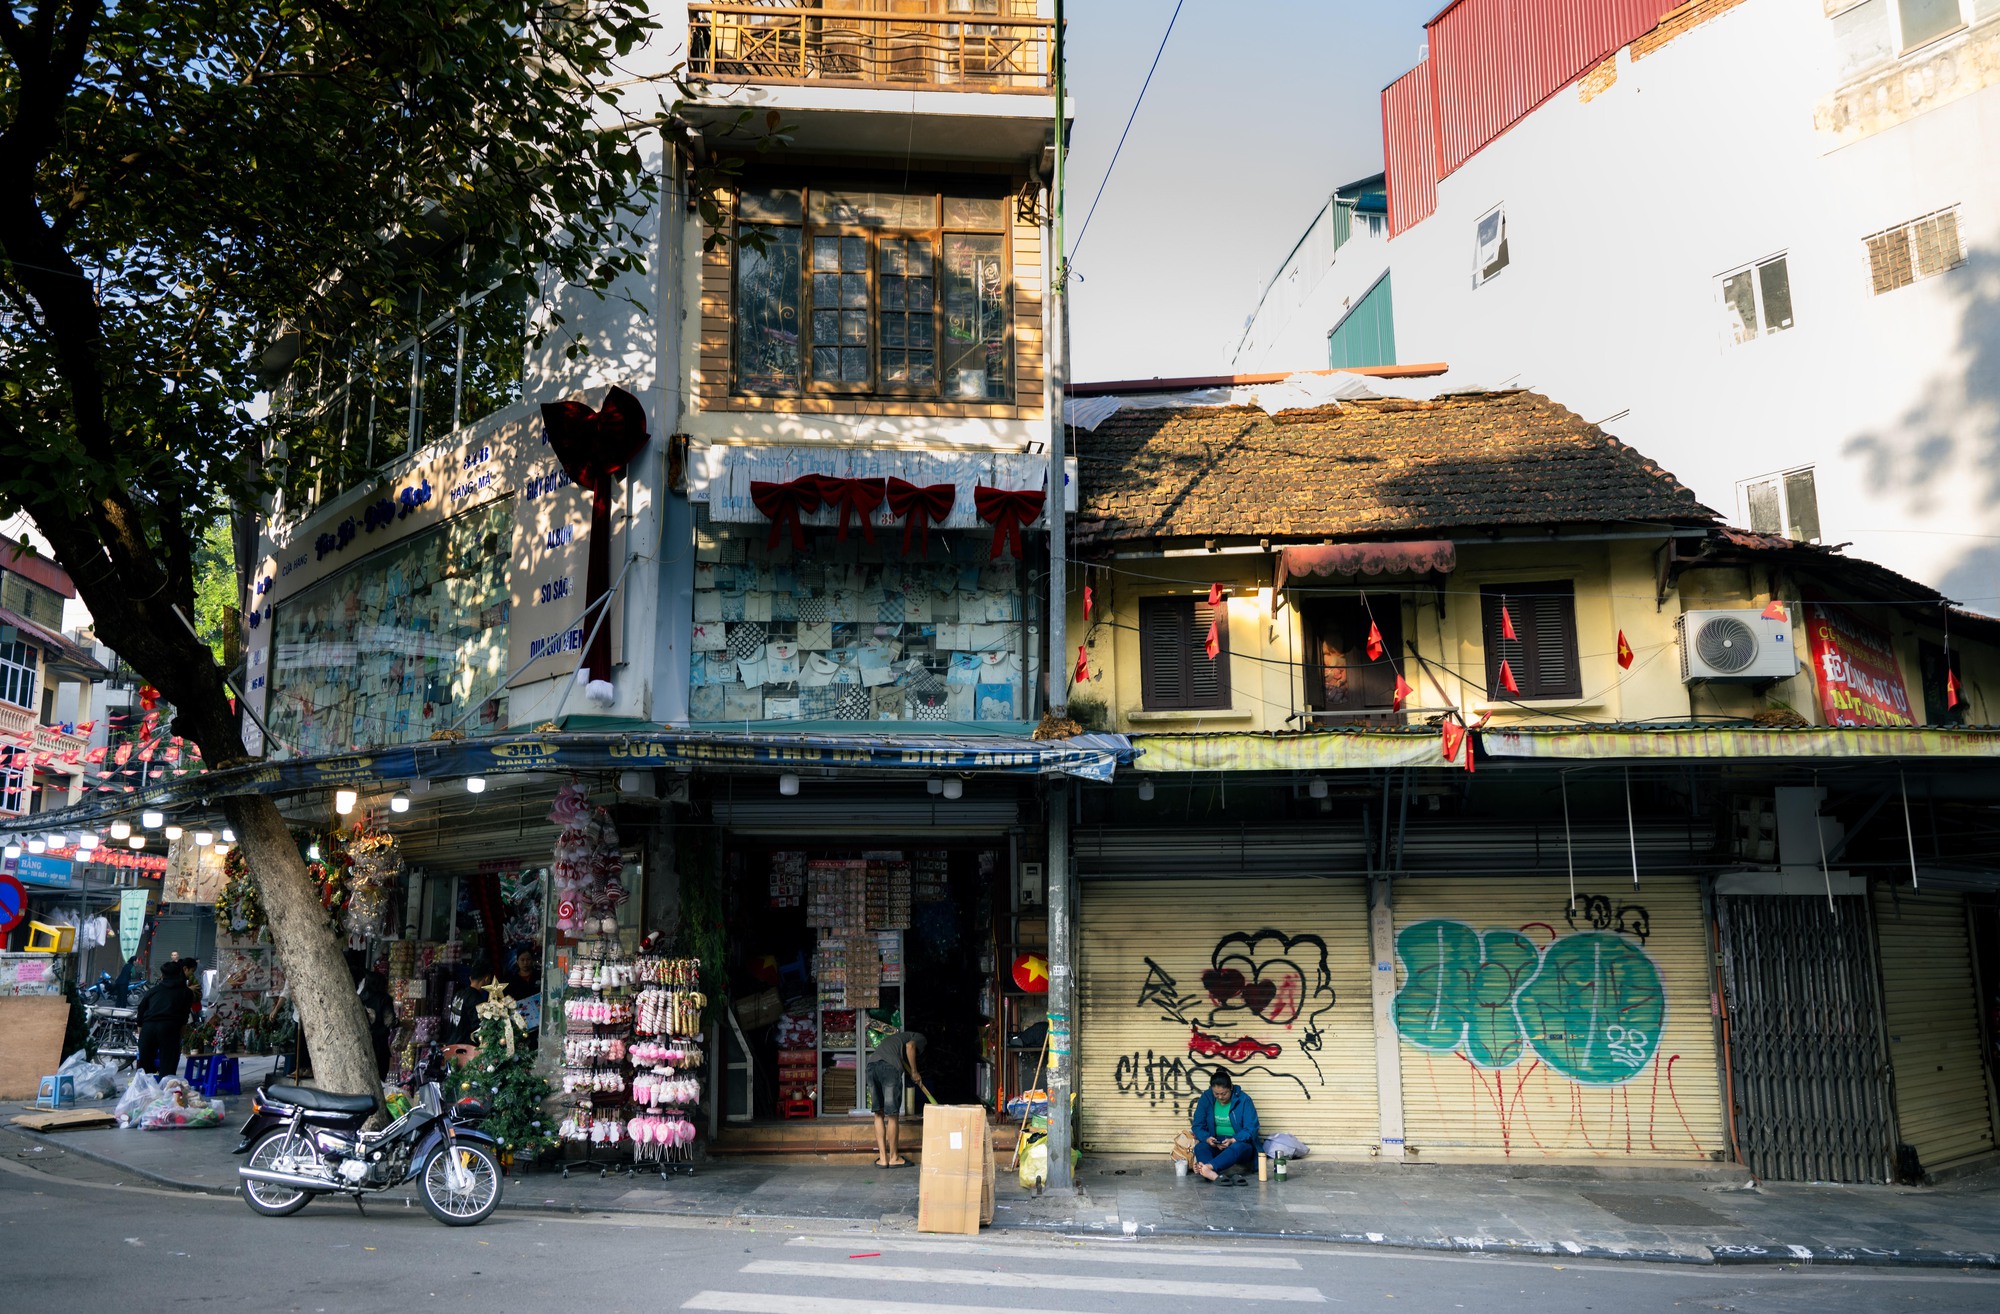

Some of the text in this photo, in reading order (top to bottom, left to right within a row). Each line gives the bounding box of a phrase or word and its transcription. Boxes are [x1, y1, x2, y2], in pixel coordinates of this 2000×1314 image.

[463, 447, 489, 470] 34B
[881, 512, 896, 526] 39
[507, 744, 544, 757] 34A
[329, 757, 361, 771] 34A
